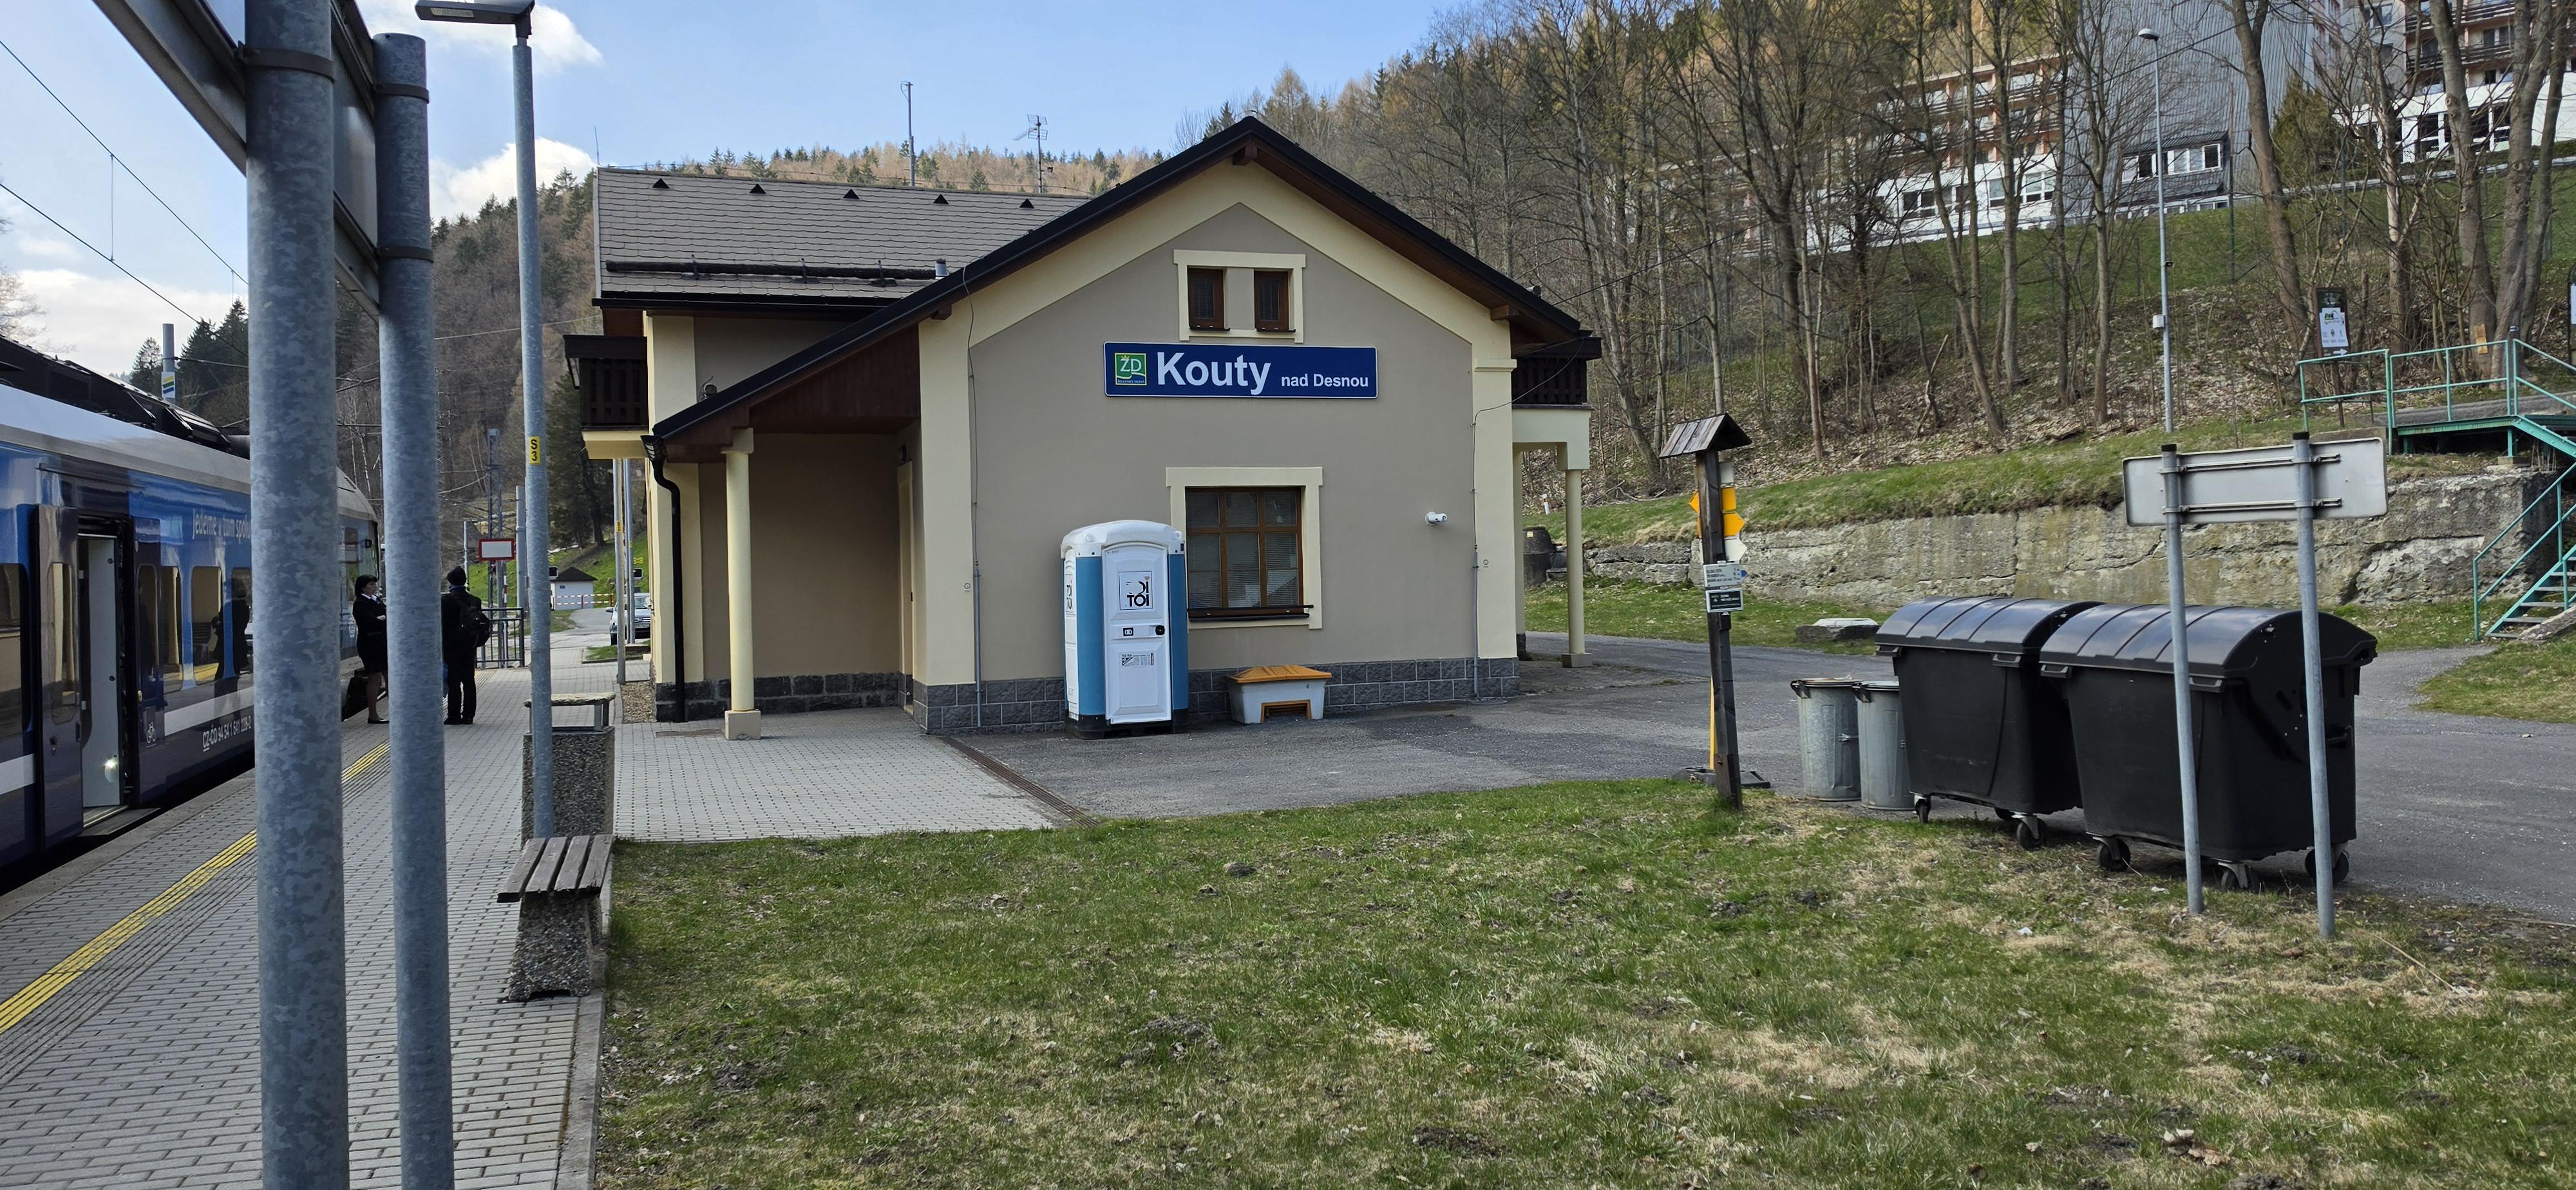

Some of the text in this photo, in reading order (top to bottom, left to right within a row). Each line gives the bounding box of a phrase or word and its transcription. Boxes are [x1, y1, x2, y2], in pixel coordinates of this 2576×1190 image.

[1157, 352, 1369, 395] Kouty nad Desnou
[1126, 594, 1150, 607] TOI
